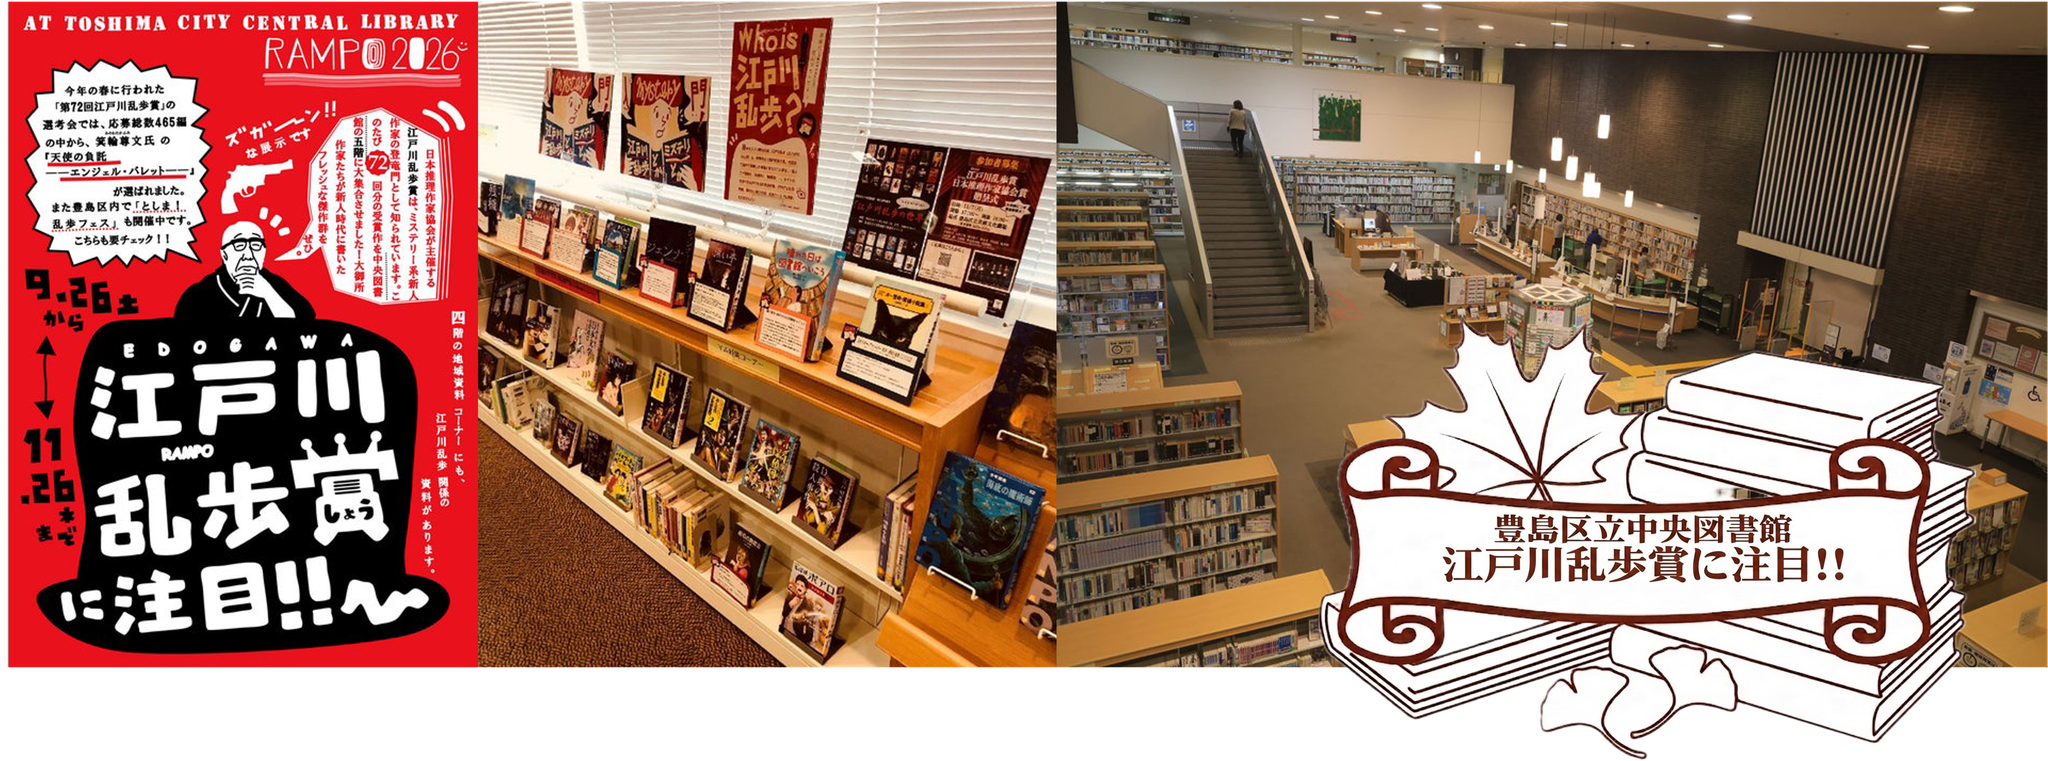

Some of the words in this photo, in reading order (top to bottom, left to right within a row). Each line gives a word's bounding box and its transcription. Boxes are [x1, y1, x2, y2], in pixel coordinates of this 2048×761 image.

[23, 14, 52, 31] AT
[64, 15, 167, 32] TOSHIMA
[177, 13, 231, 31] CITY
[243, 13, 349, 31] CENTRAL
[360, 12, 460, 30] LIBRARY
[739, 23, 779, 54] Who
[781, 22, 799, 50] is
[264, 37, 386, 71] RAMPO
[392, 37, 461, 71] 2026
[735, 54, 800, 95] 江戸川
[64, 83, 165, 97] 今年の春に行われた
[42, 116, 188, 131] 選考会では、応募総数465編
[245, 128, 311, 159] な展示です
[976, 155, 1020, 170] 参加者募集
[952, 179, 1029, 198] 日本推理作家協会賞
[966, 170, 1019, 186] 江戸川乱歩賞
[113, 186, 186, 198] が選ばれました。
[317, 150, 329, 245] フレッシュな傑作群を
[334, 139, 347, 275] 作家たちが新人時代に書いた
[407, 127, 419, 301] 江戸川乱歩賞は、ミステリー系新人
[425, 149, 436, 288] 日本推理作家協会が主催する
[43, 310, 84, 332] から
[123, 333, 353, 359] EDOGAWA
[90, 350, 386, 440] 江戸川
[23, 427, 62, 463] 11
[161, 444, 215, 462] RAMPO
[94, 431, 399, 557] 乱歩賞
[985, 479, 1034, 506] 海底の魔術師
[323, 499, 375, 524] しょう
[36, 525, 77, 547] まで
